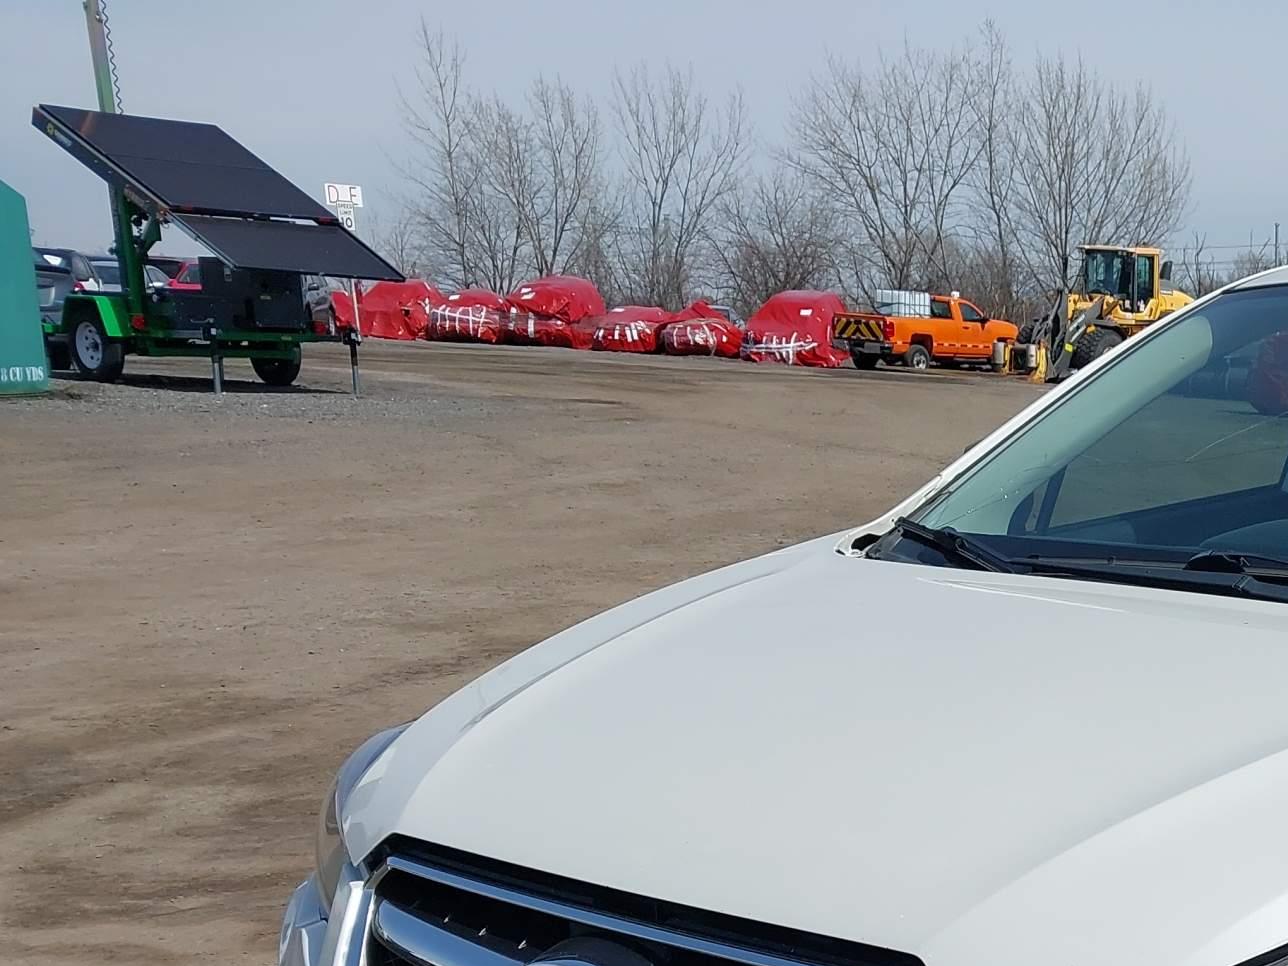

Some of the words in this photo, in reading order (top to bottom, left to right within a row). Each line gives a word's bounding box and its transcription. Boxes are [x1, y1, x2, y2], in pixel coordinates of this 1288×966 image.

[327, 184, 339, 203] D
[349, 186, 359, 206] E
[341, 216, 353, 228] 10
[10, 366, 23, 382] CU
[25, 366, 44, 381] YDS
